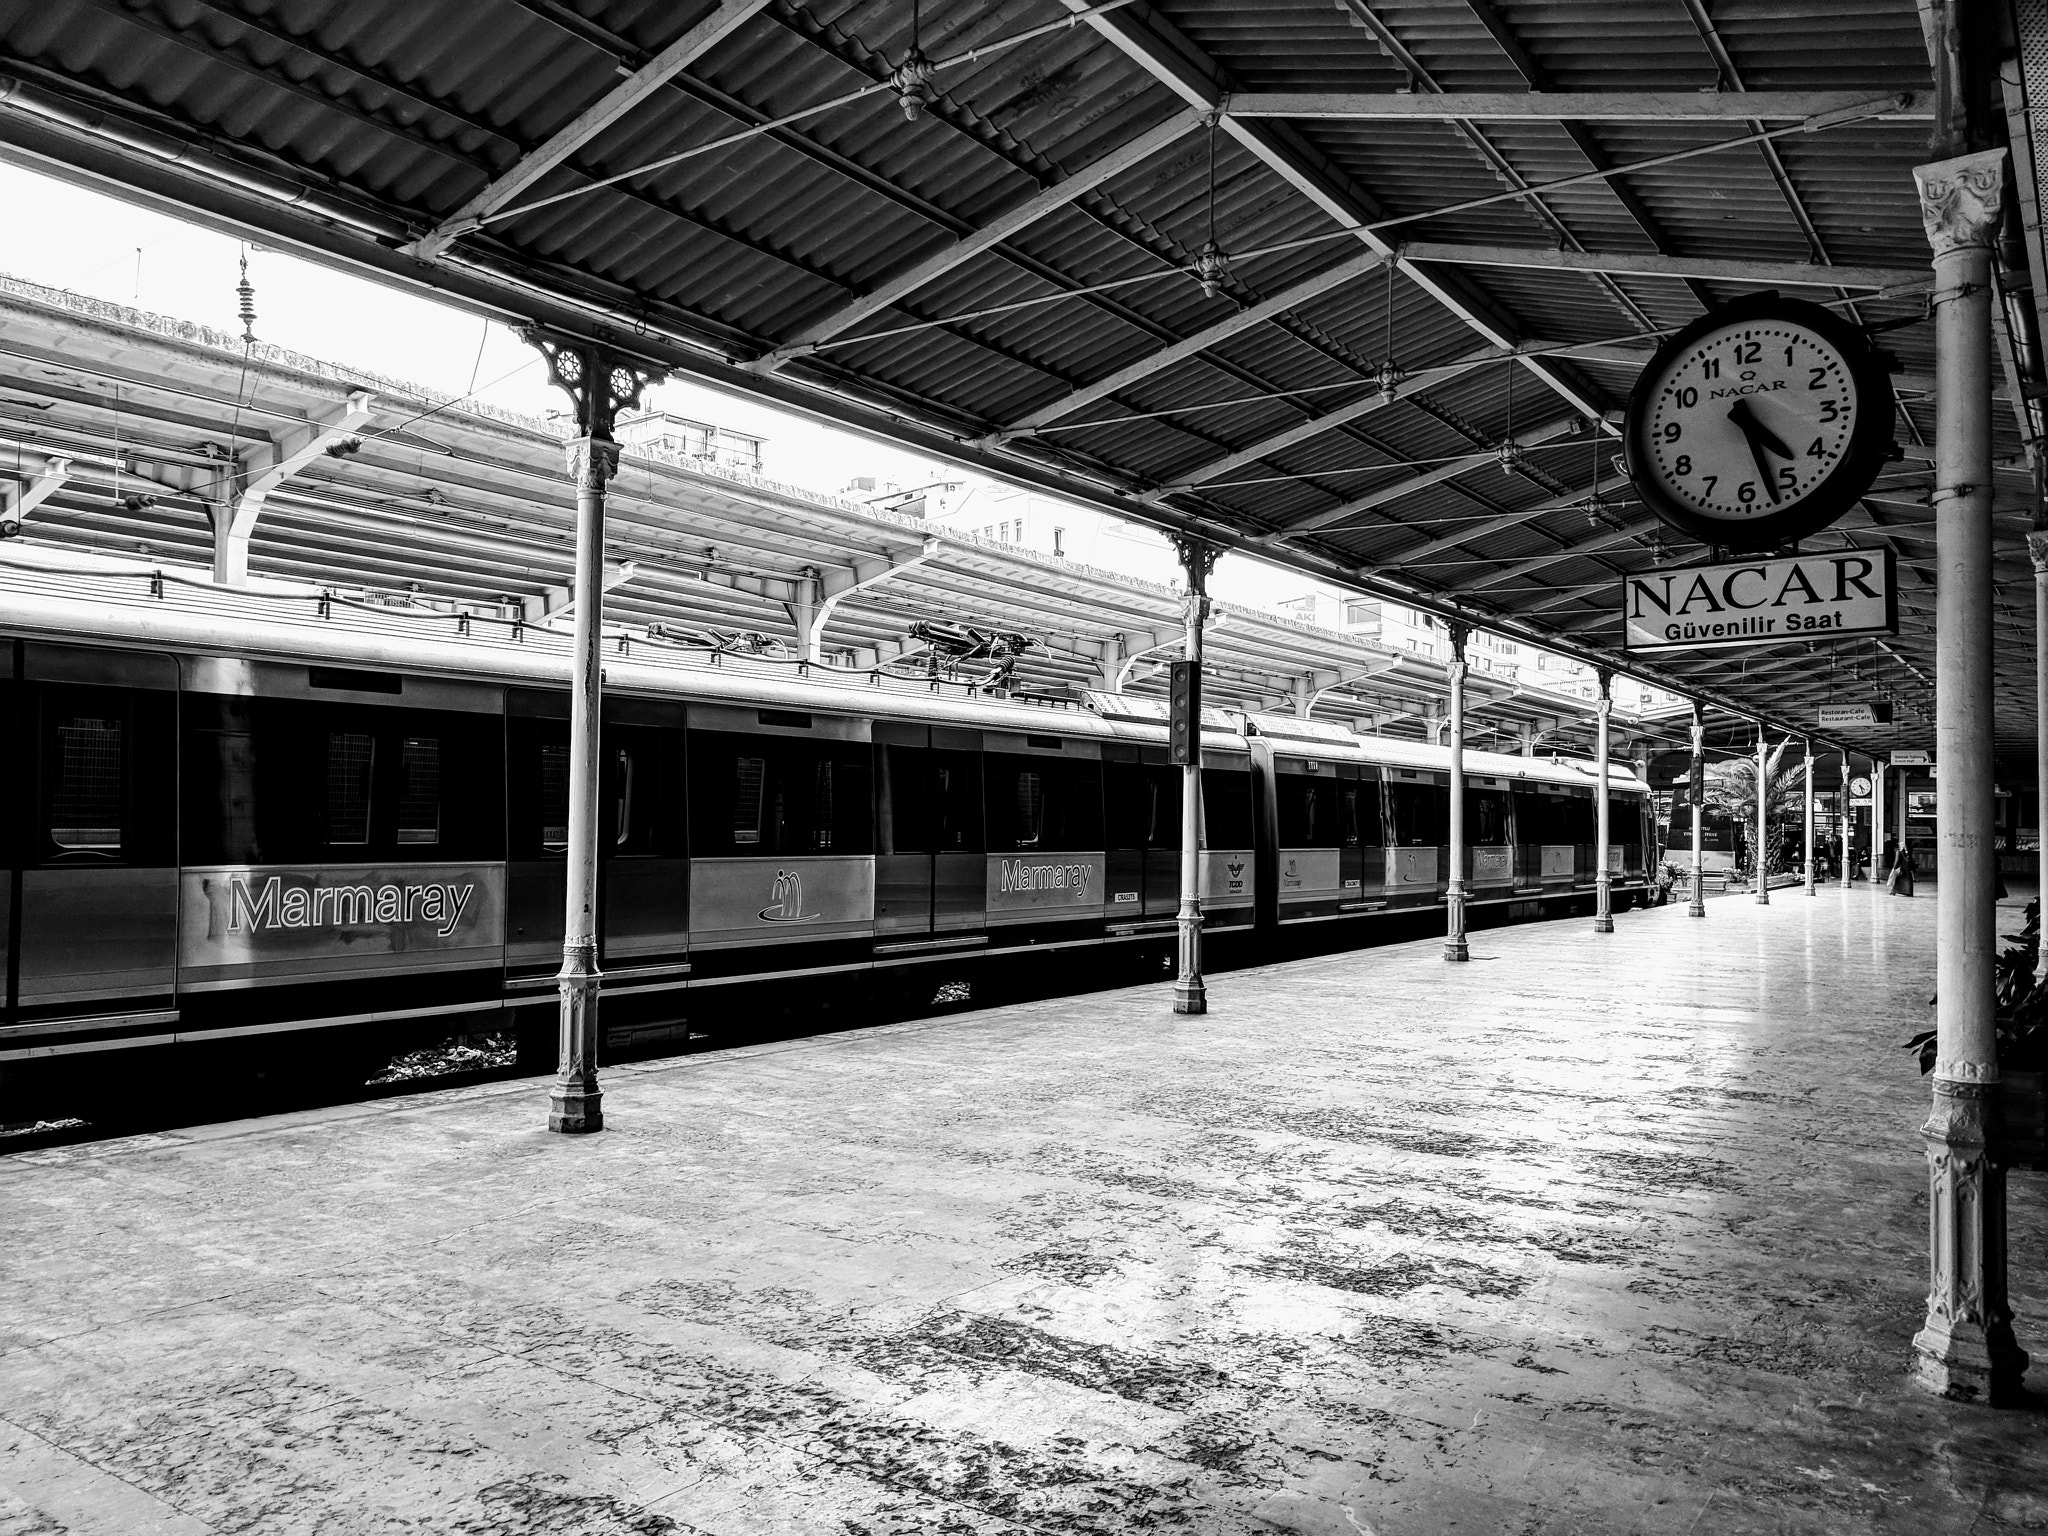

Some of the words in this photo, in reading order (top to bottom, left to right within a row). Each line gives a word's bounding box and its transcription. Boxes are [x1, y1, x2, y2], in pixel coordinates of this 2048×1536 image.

[1734, 341, 1763, 365] 12
[1784, 345, 1794, 367] 1
[1702, 357, 1720, 379] 11
[1808, 367, 1828, 390] 2
[1674, 386, 1698, 409] 10
[1709, 379, 1788, 400] NACAR
[1820, 400, 1838, 423] 3
[1664, 422, 1682, 444] 9
[1806, 437, 1827, 459] 4
[1674, 454, 1692, 476] 8
[1702, 475, 1718, 497] 7
[1779, 466, 1798, 490] 5
[1737, 481, 1756, 503] 6
[1627, 557, 1882, 619] NACAR
[1664, 618, 1776, 641] Güvenilir
[1785, 611, 1843, 632] Saat
[1000, 859, 1092, 897] Marmaray
[227, 876, 474, 937] Marmaray
